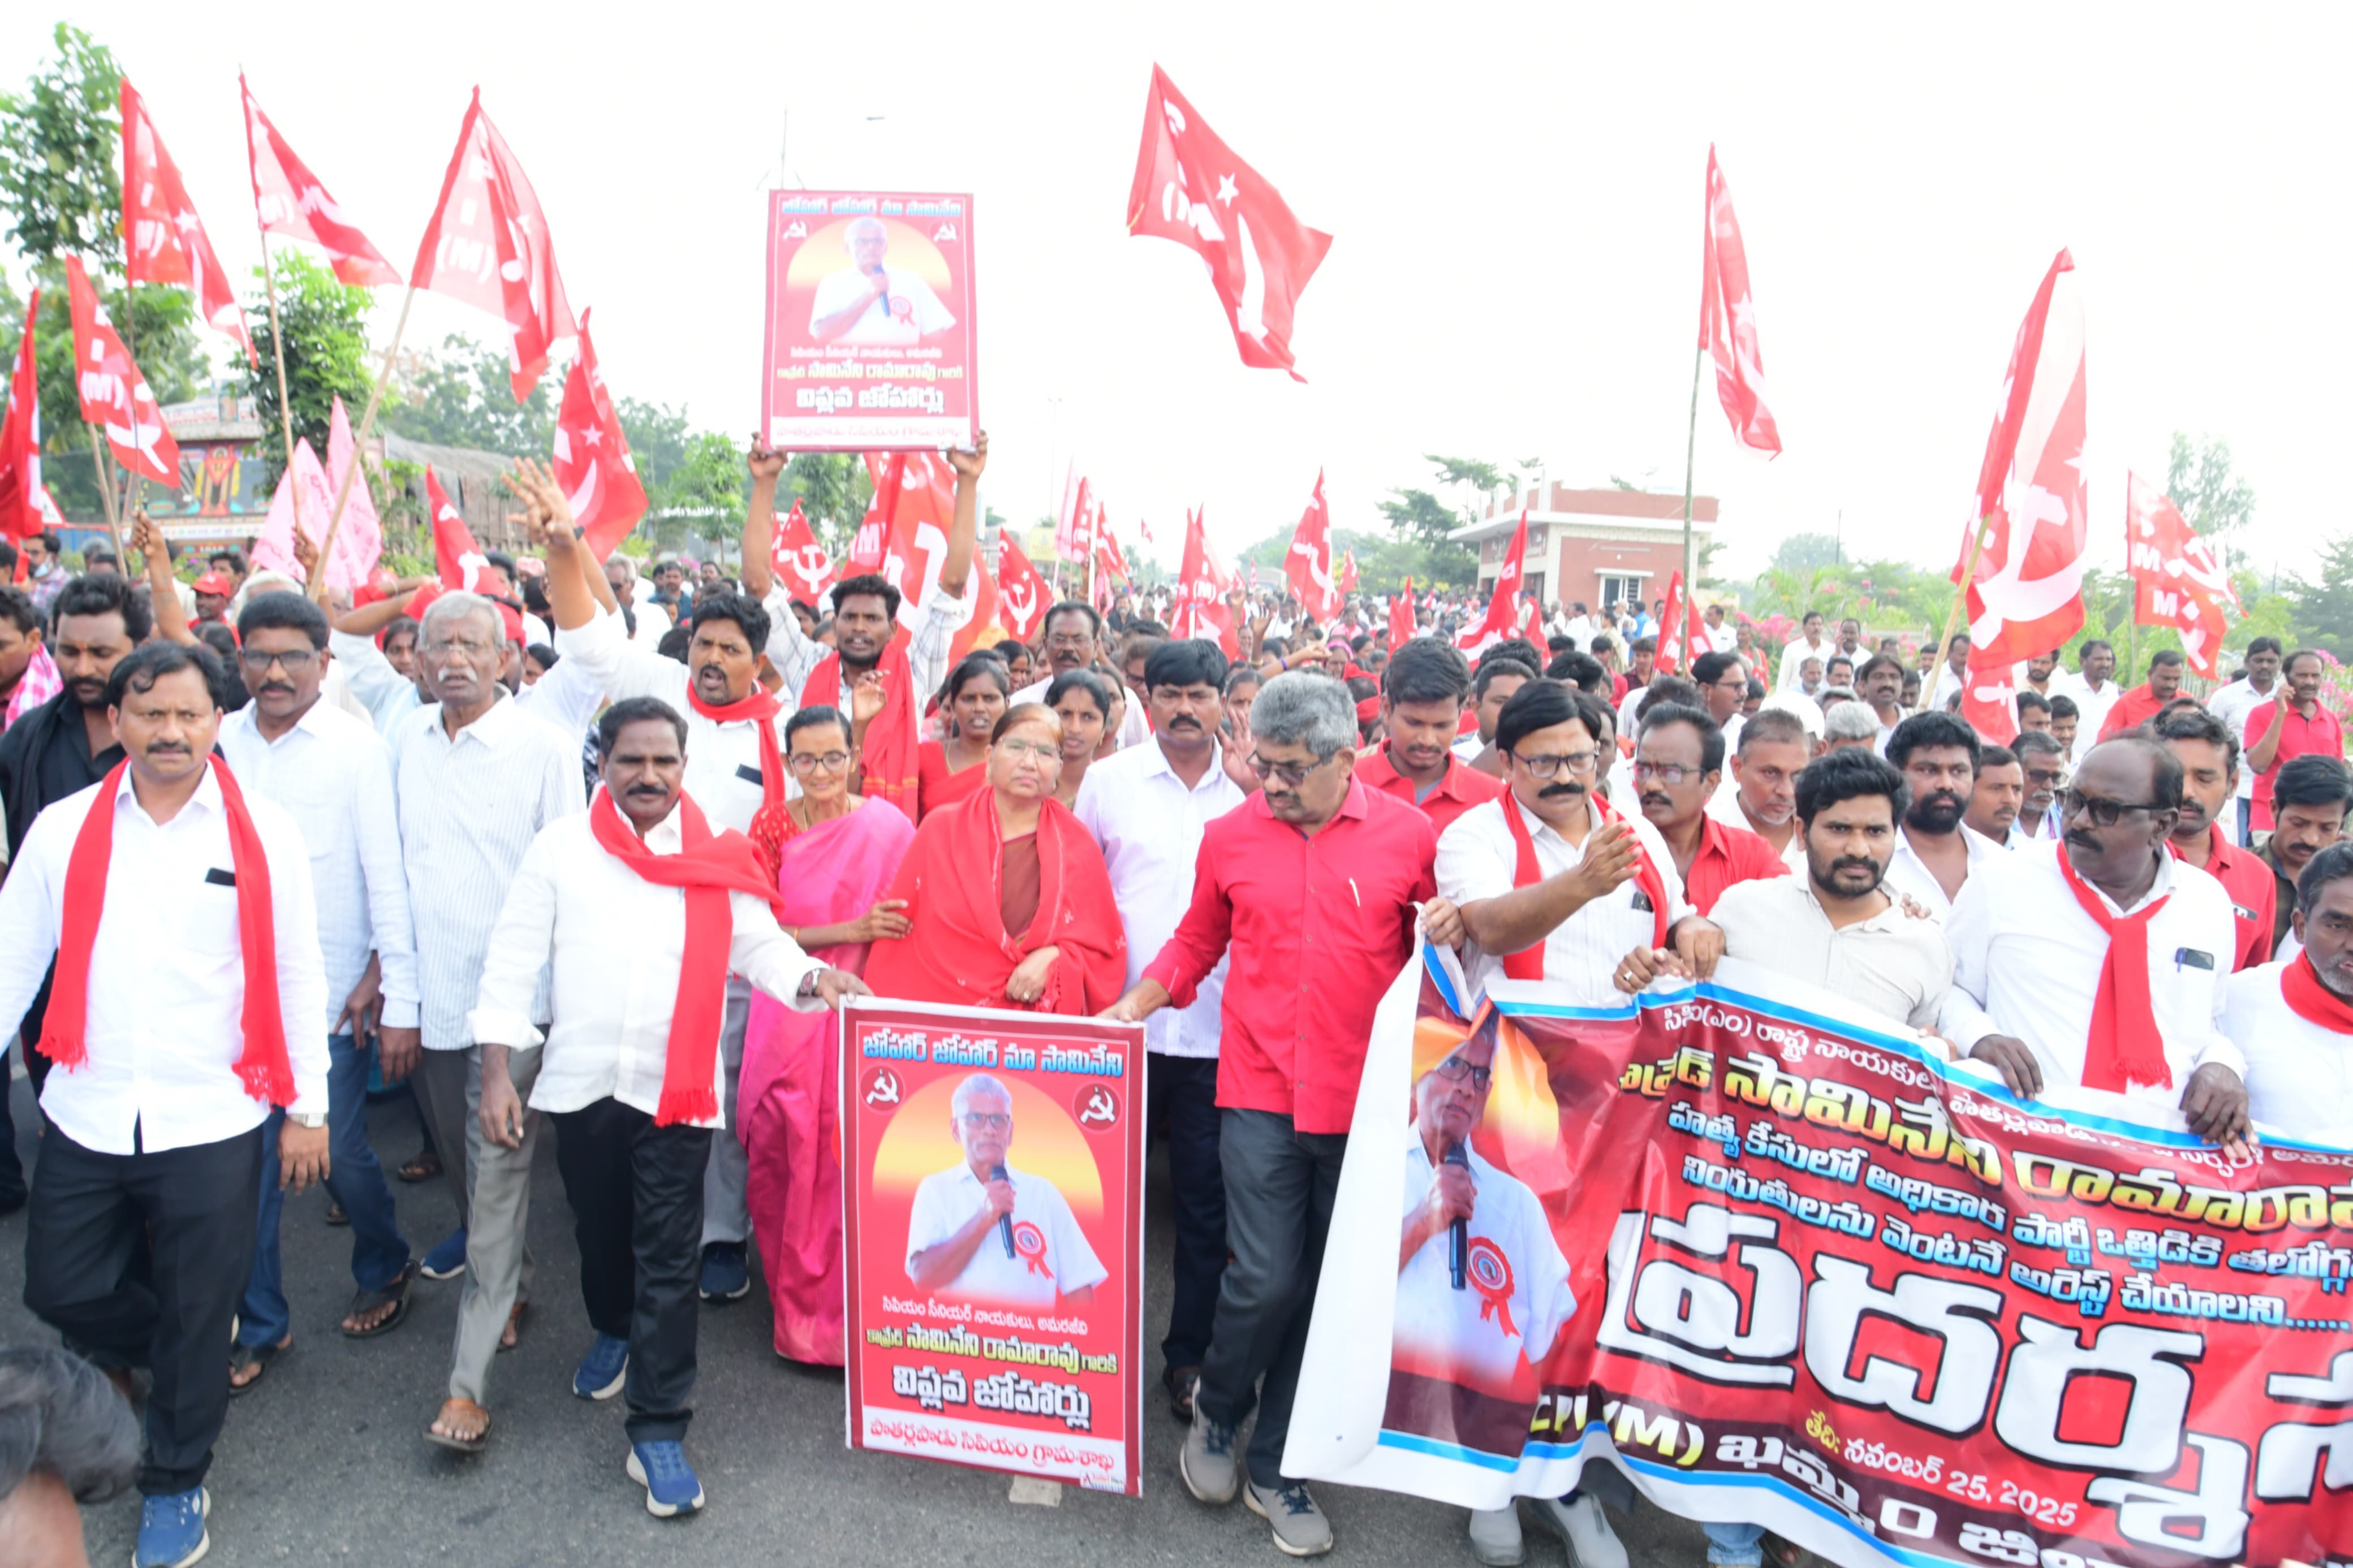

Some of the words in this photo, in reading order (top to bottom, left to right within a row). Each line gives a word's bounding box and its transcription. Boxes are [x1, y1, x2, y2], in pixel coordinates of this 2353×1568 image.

[863, 1028, 928, 1062] జోహార్
[933, 1034, 999, 1069] జోహార్
[1003, 1043, 1036, 1071] మా
[1041, 1044, 1124, 1078] సామినేని
[1668, 1100, 1742, 1159] హత్య
[1744, 1120, 1869, 1184] కేసులో
[1865, 1163, 2007, 1232] అధికార
[2012, 1212, 2093, 1265] పార్టీ
[1881, 1213, 2007, 1276] వెంటనే
[2009, 1261, 2112, 1317] అరెస్ట్
[883, 1295, 926, 1316] సిపియం
[906, 1322, 981, 1357] సామినేని
[982, 1336, 1080, 1375] రామారావు
[892, 1365, 967, 1410] విప్లవ
[973, 1371, 1092, 1431] జోహార్లు
[1715, 1433, 1938, 1540] ఖమ్మం
[1844, 1437, 1945, 1485] నవంబర్
[1946, 1471, 1992, 1504] 25,
[1999, 1479, 2078, 1527] 2025
